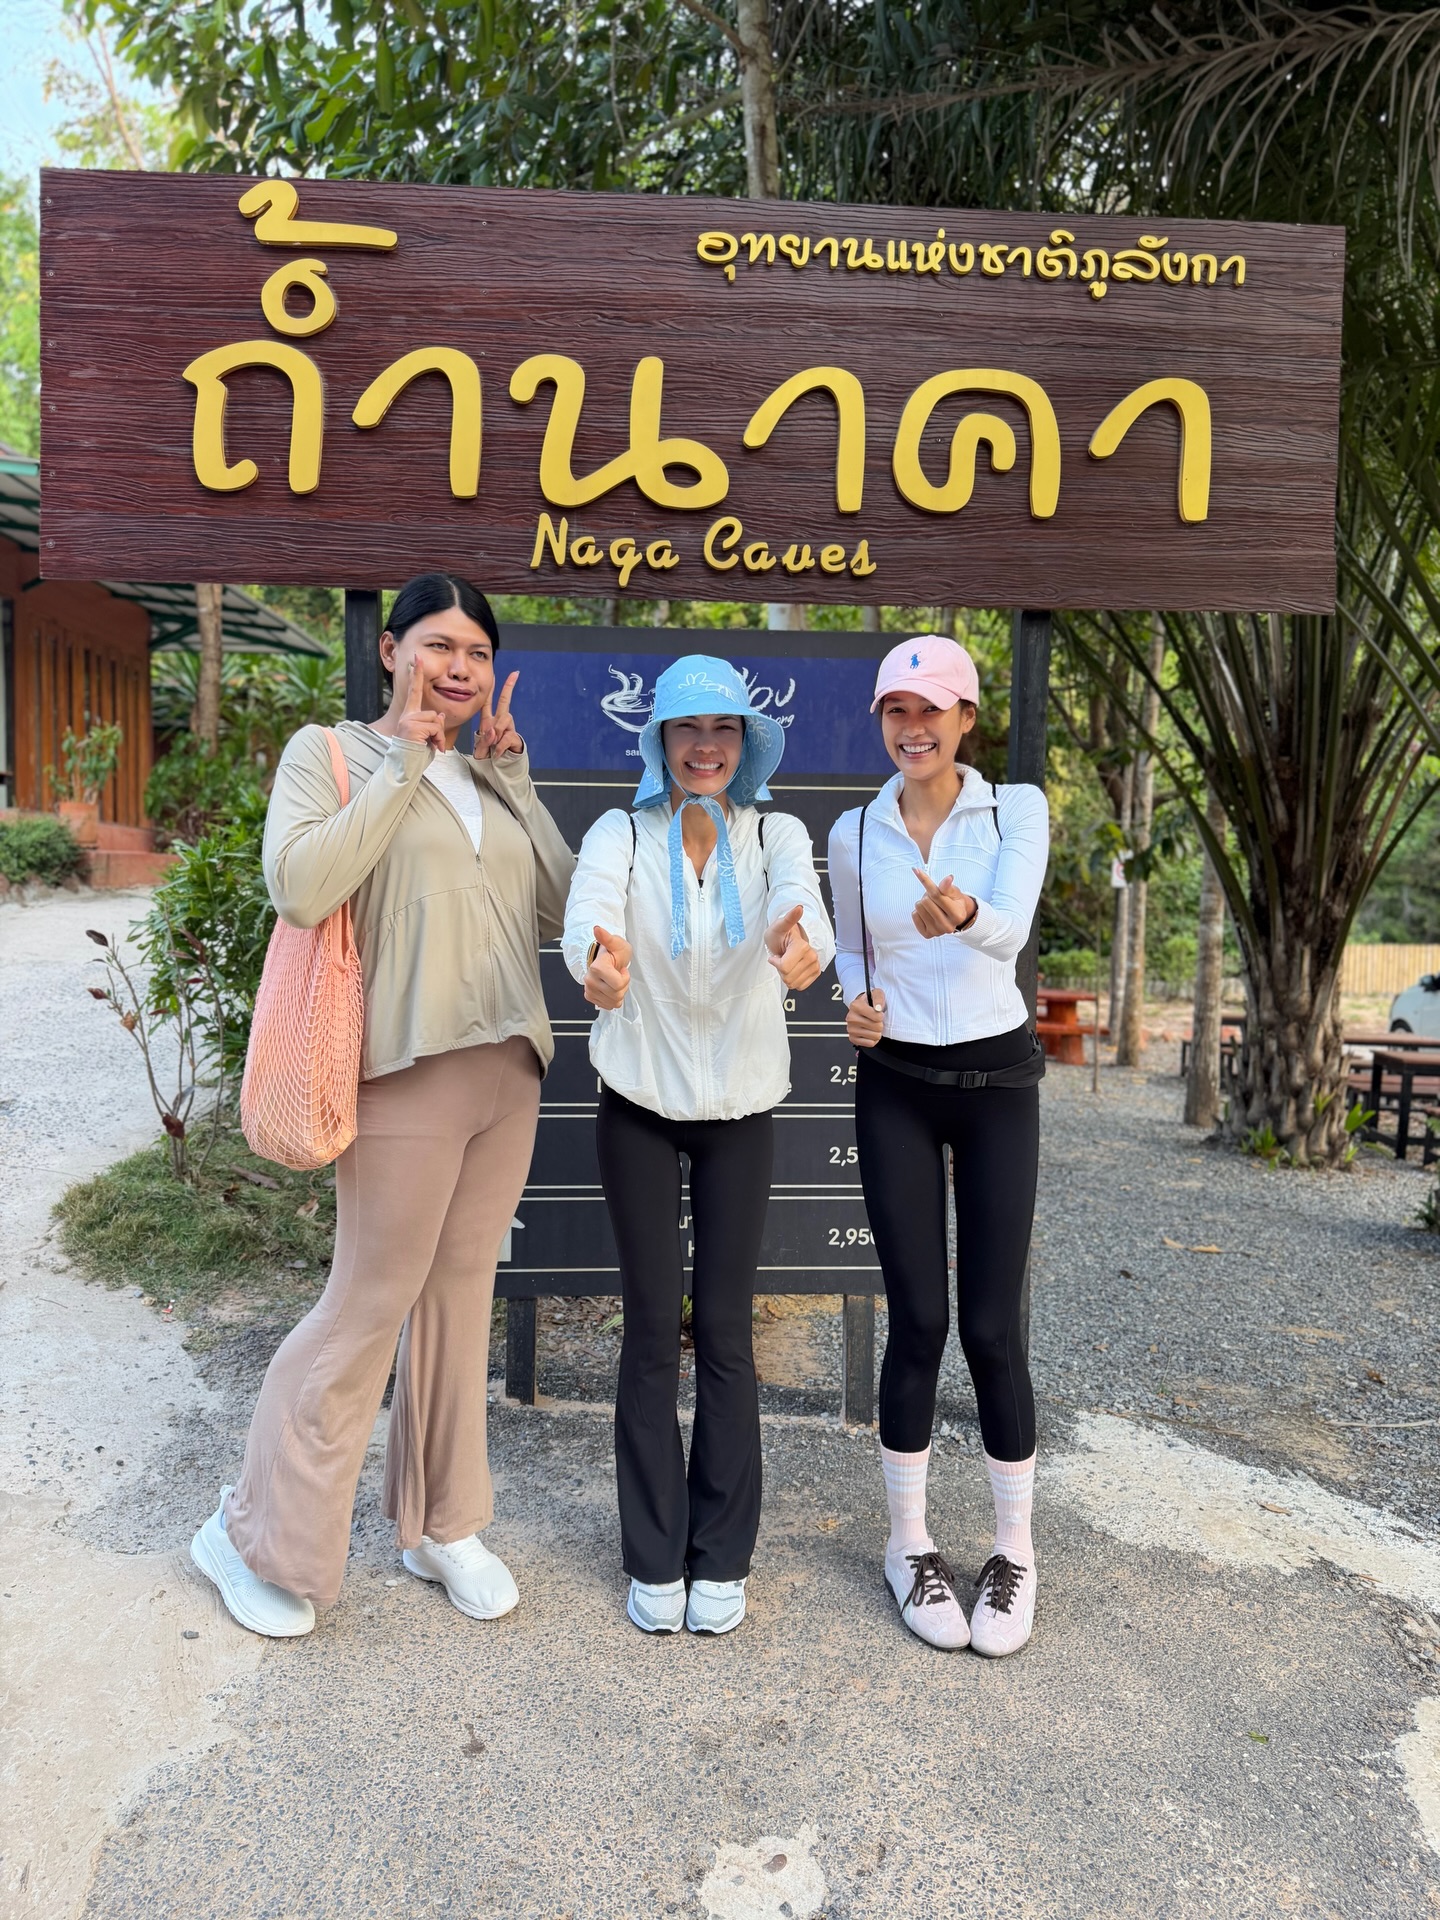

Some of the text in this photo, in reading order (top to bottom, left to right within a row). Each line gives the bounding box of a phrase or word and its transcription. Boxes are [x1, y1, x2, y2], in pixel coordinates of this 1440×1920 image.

[696, 228, 1247, 300] อุทยานแห่งชาติภูลังกา
[182, 180, 1212, 523] ถ้ำนาคา
[530, 512, 877, 588] Naga Caves
